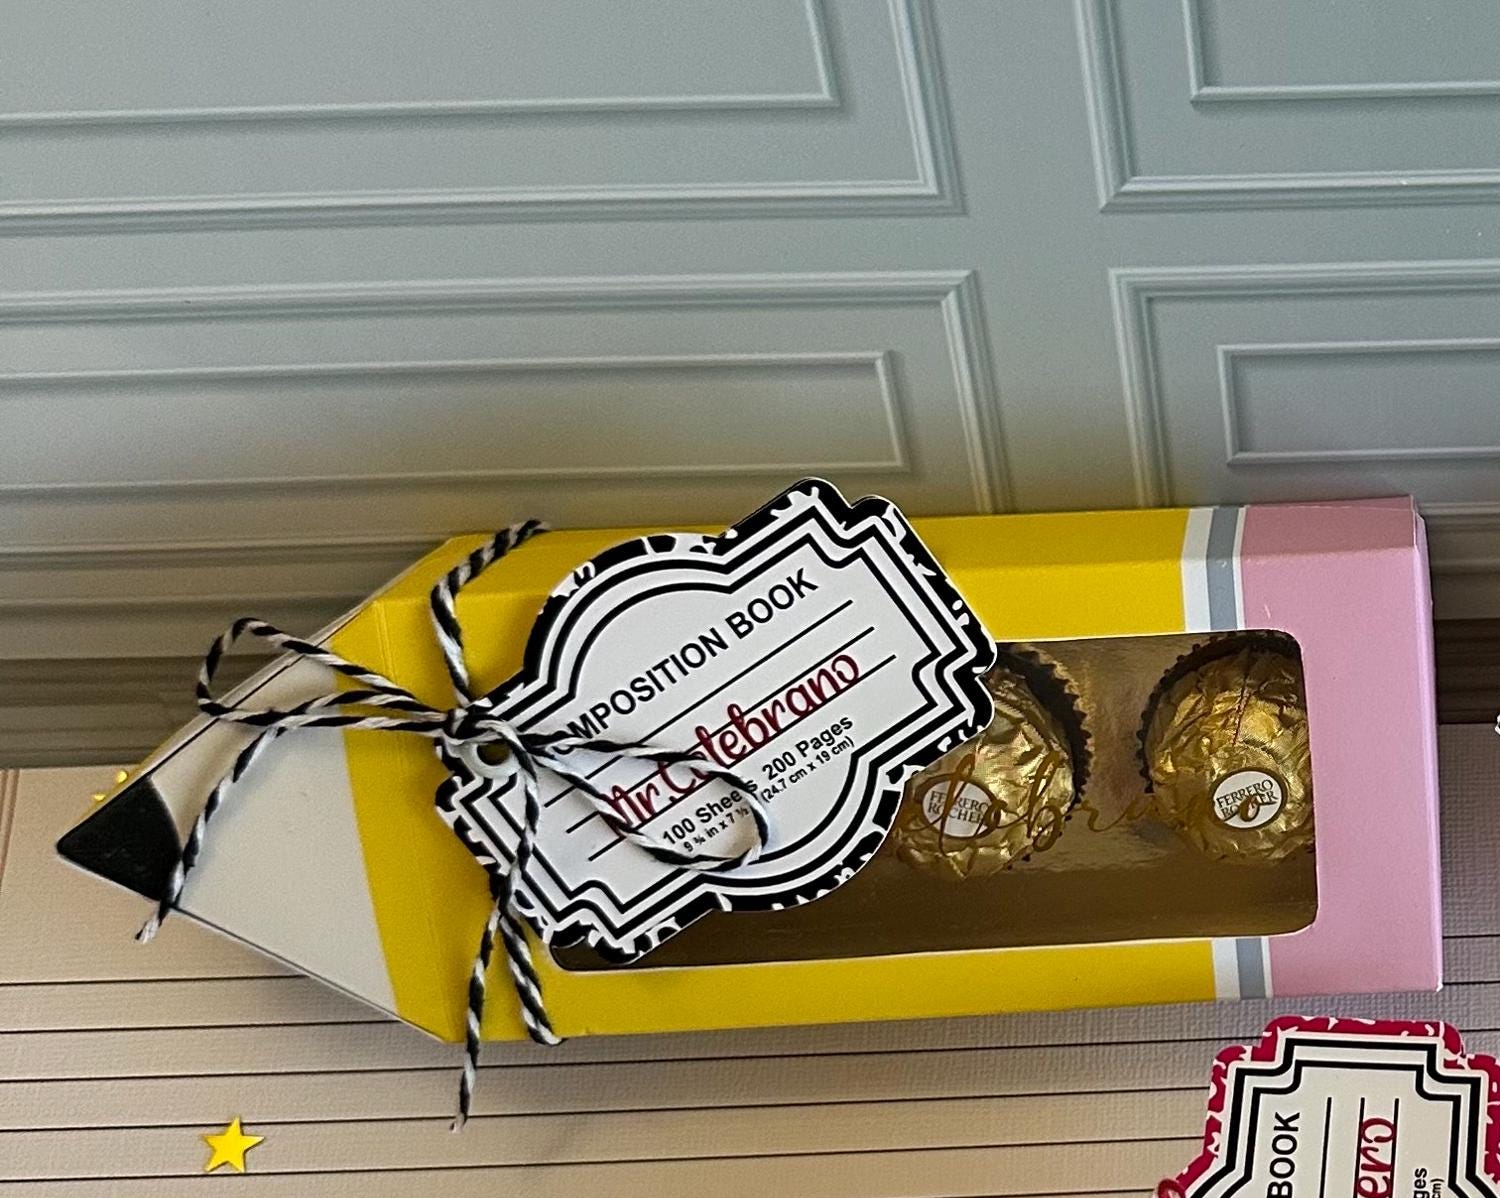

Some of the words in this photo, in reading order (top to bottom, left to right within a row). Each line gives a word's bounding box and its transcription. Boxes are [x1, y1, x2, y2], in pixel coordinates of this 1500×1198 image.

[725, 567, 819, 640] BOOK
[663, 818, 696, 846] 100
[695, 779, 758, 823] Shees
[762, 751, 797, 780] 200
[795, 716, 854, 758] Pages
[683, 840, 693, 852] 9
[706, 826, 720, 839] in
[719, 820, 729, 830] x
[725, 812, 735, 824] 7
[760, 778, 788, 803] (24.7
[789, 768, 808, 784] cm
[806, 761, 816, 771] x
[816, 751, 832, 764] 19
[831, 734, 855, 757] cm)
[1216, 779, 1274, 809] FERRERO
